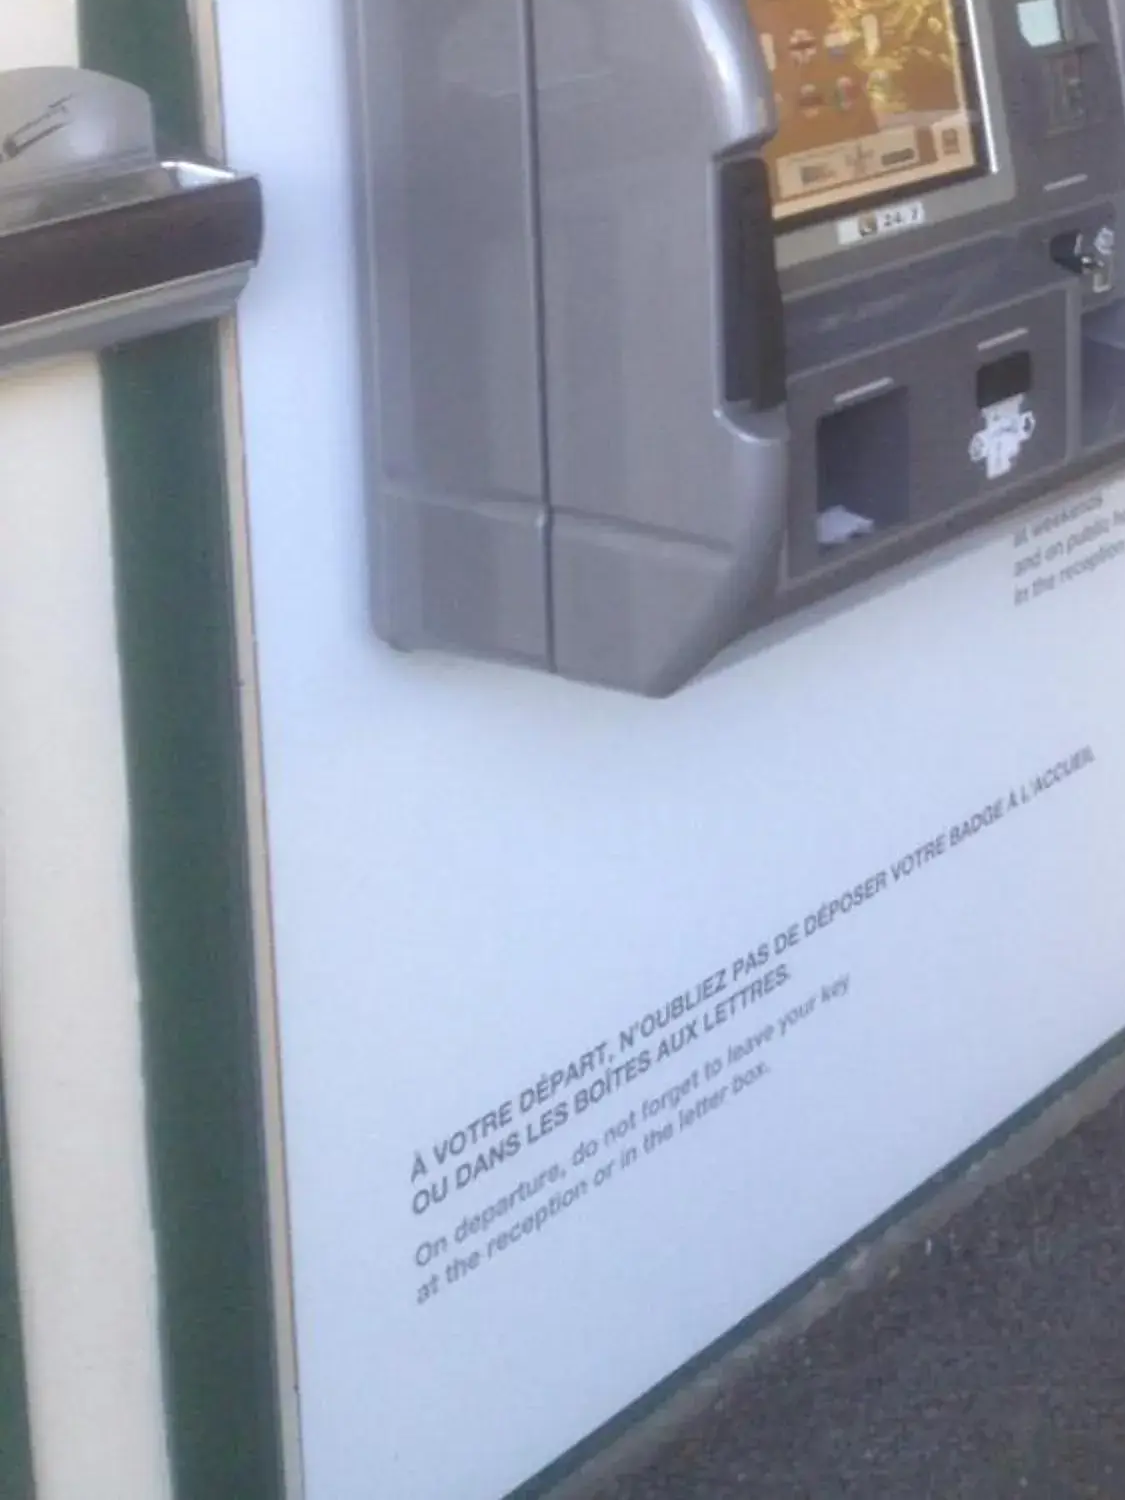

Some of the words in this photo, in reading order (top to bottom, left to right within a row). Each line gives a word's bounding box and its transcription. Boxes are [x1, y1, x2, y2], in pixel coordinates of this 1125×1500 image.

[432, 1099, 513, 1165] VOTRE
[618, 968, 728, 1053] N'OUBLIEZ
[731, 943, 770, 982] PAS
[774, 923, 801, 955] DE
[803, 870, 889, 938] DÉPOSER
[890, 833, 946, 883] VOTRE
[949, 797, 1005, 847] BADGE
[411, 1174, 449, 1216] OU
[455, 1131, 523, 1190] DANS
[525, 1100, 570, 1145] LES
[573, 1049, 653, 1115] BOÎTES
[656, 1019, 699, 1063] AUX
[415, 1235, 449, 1267] On
[571, 1139, 599, 1168] do
[603, 1109, 637, 1147] not
[641, 1069, 700, 1122] forget
[703, 1055, 723, 1082] to
[726, 1022, 776, 1066] leave
[777, 996, 818, 1037] your
[416, 1273, 440, 1305] at
[444, 1251, 482, 1285] the
[486, 1179, 589, 1261] reception
[592, 1159, 616, 1188] or
[620, 1146, 639, 1170] in
[642, 1121, 674, 1155] the
[679, 1085, 730, 1132] letter
